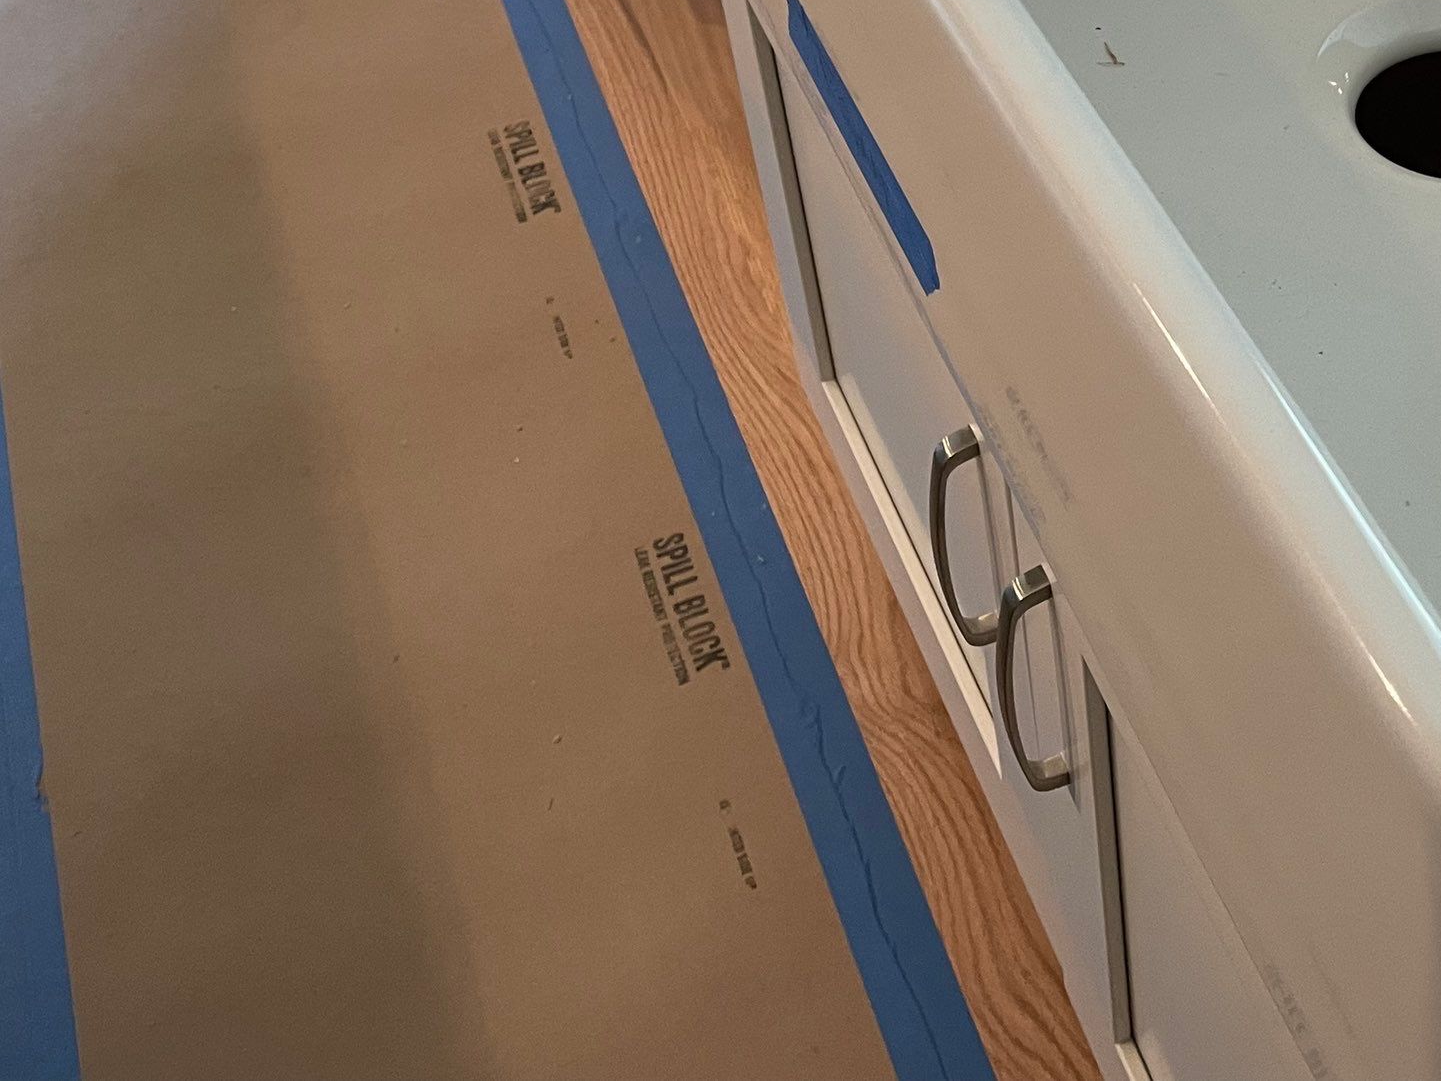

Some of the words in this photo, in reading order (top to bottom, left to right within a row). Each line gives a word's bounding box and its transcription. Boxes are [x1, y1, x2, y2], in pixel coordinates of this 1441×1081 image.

[503, 120, 539, 164] SPILL
[653, 532, 698, 596] SPILL
[673, 595, 729, 671] BLOCK
